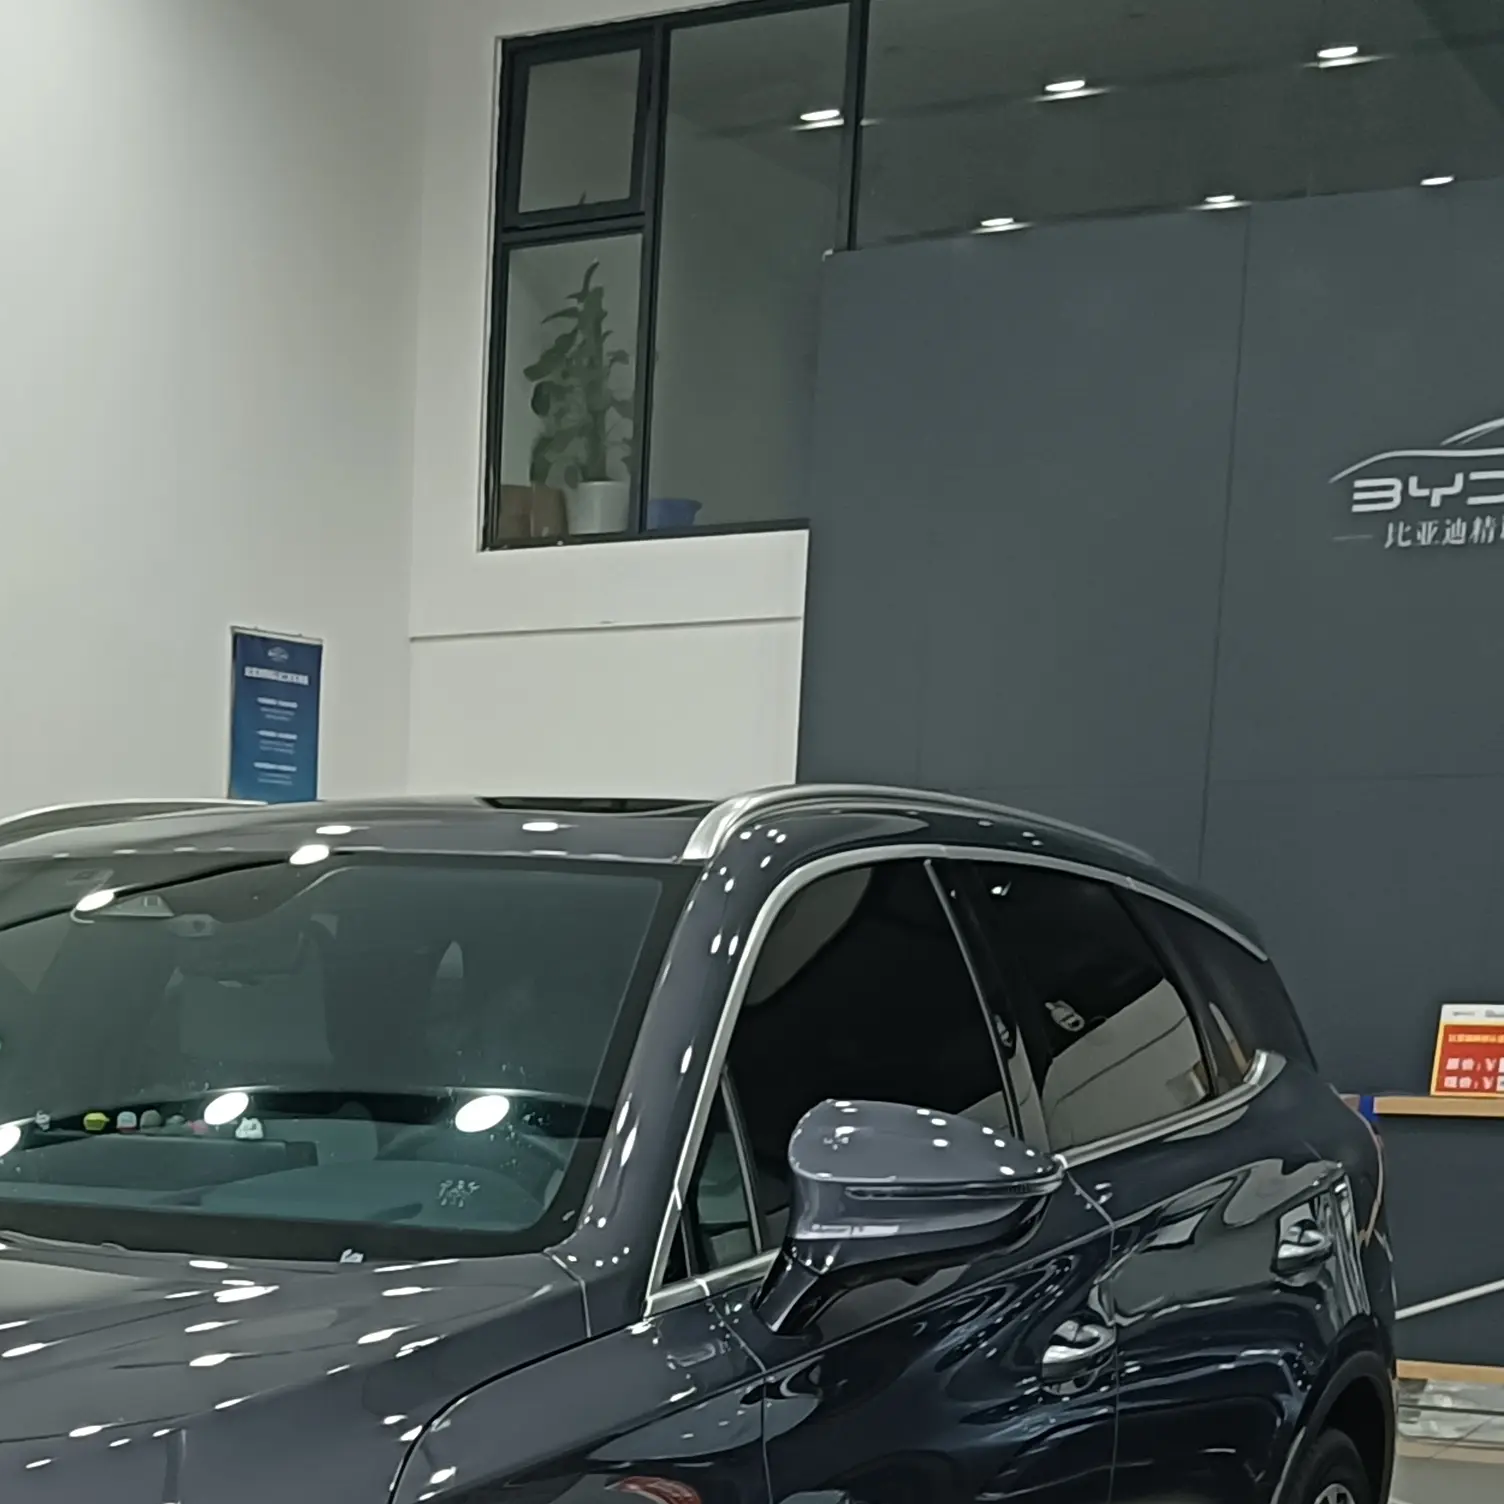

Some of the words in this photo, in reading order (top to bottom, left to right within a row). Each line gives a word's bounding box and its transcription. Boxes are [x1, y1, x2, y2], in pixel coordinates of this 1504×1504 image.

[1351, 470, 1504, 513] BYD
[1384, 514, 1504, 549] 比亚迪精
